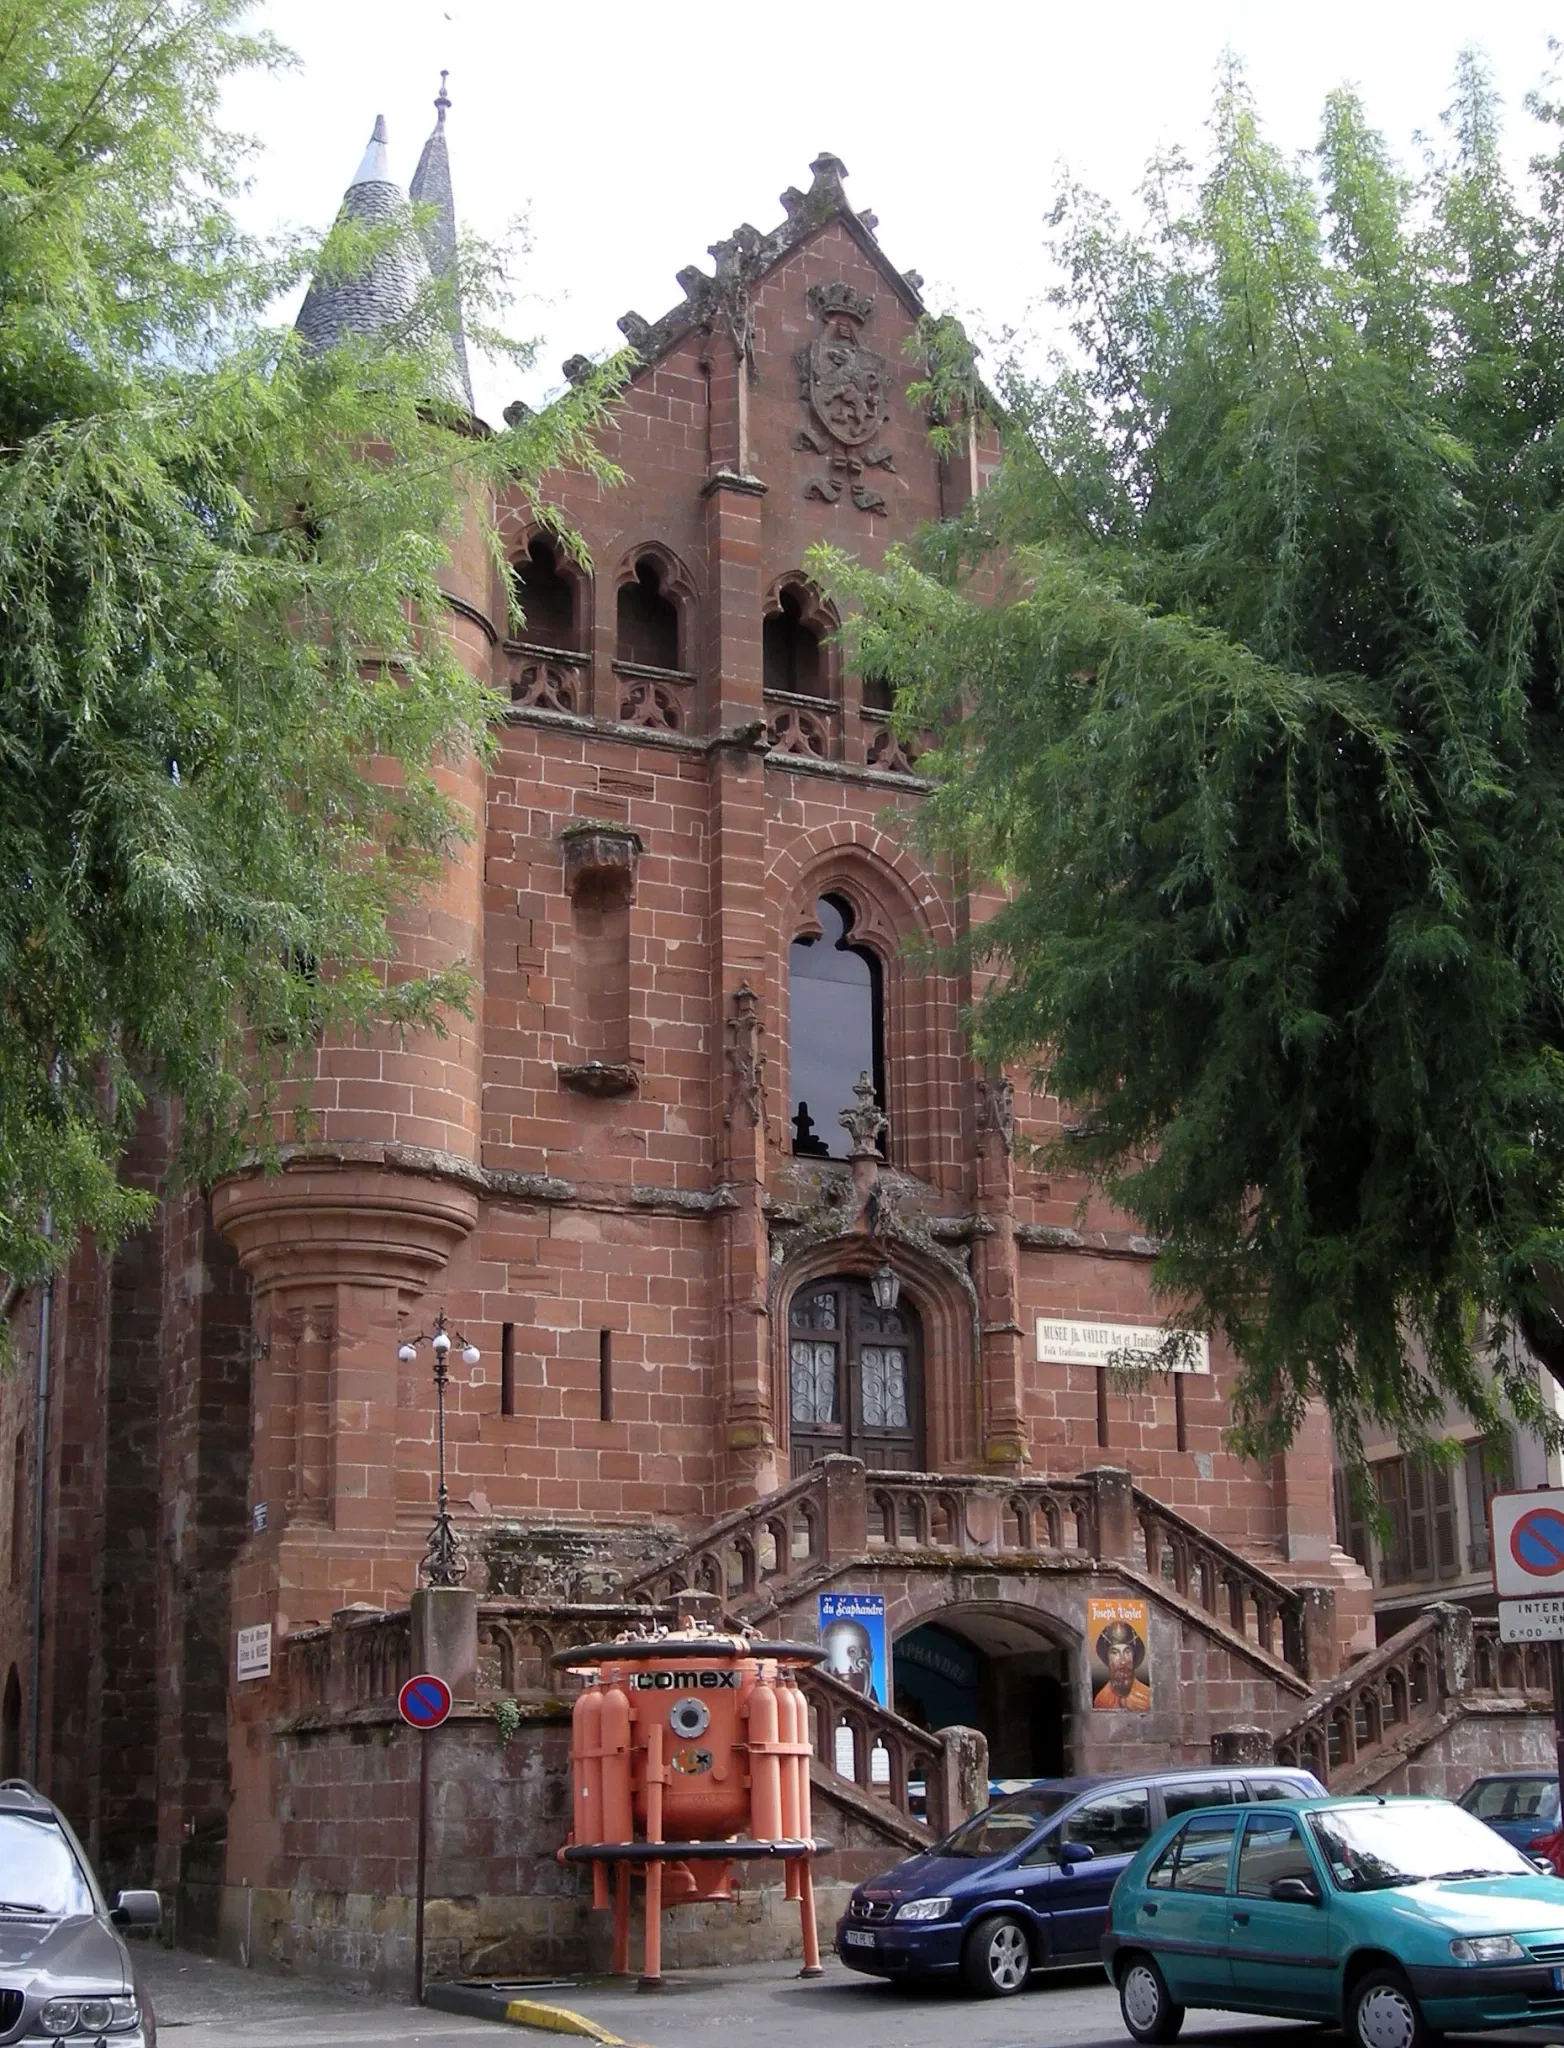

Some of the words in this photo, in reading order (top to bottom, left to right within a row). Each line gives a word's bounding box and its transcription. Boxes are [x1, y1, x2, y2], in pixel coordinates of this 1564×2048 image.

[1082, 1328, 1109, 1345] VAYLET
[1111, 1331, 1122, 1346] Art
[1124, 1334, 1131, 1347] et
[823, 1602, 834, 1615] du
[835, 1601, 884, 1617] Scaphandre
[1092, 1607, 1117, 1621] Joseph
[637, 1671, 734, 1690] comex
